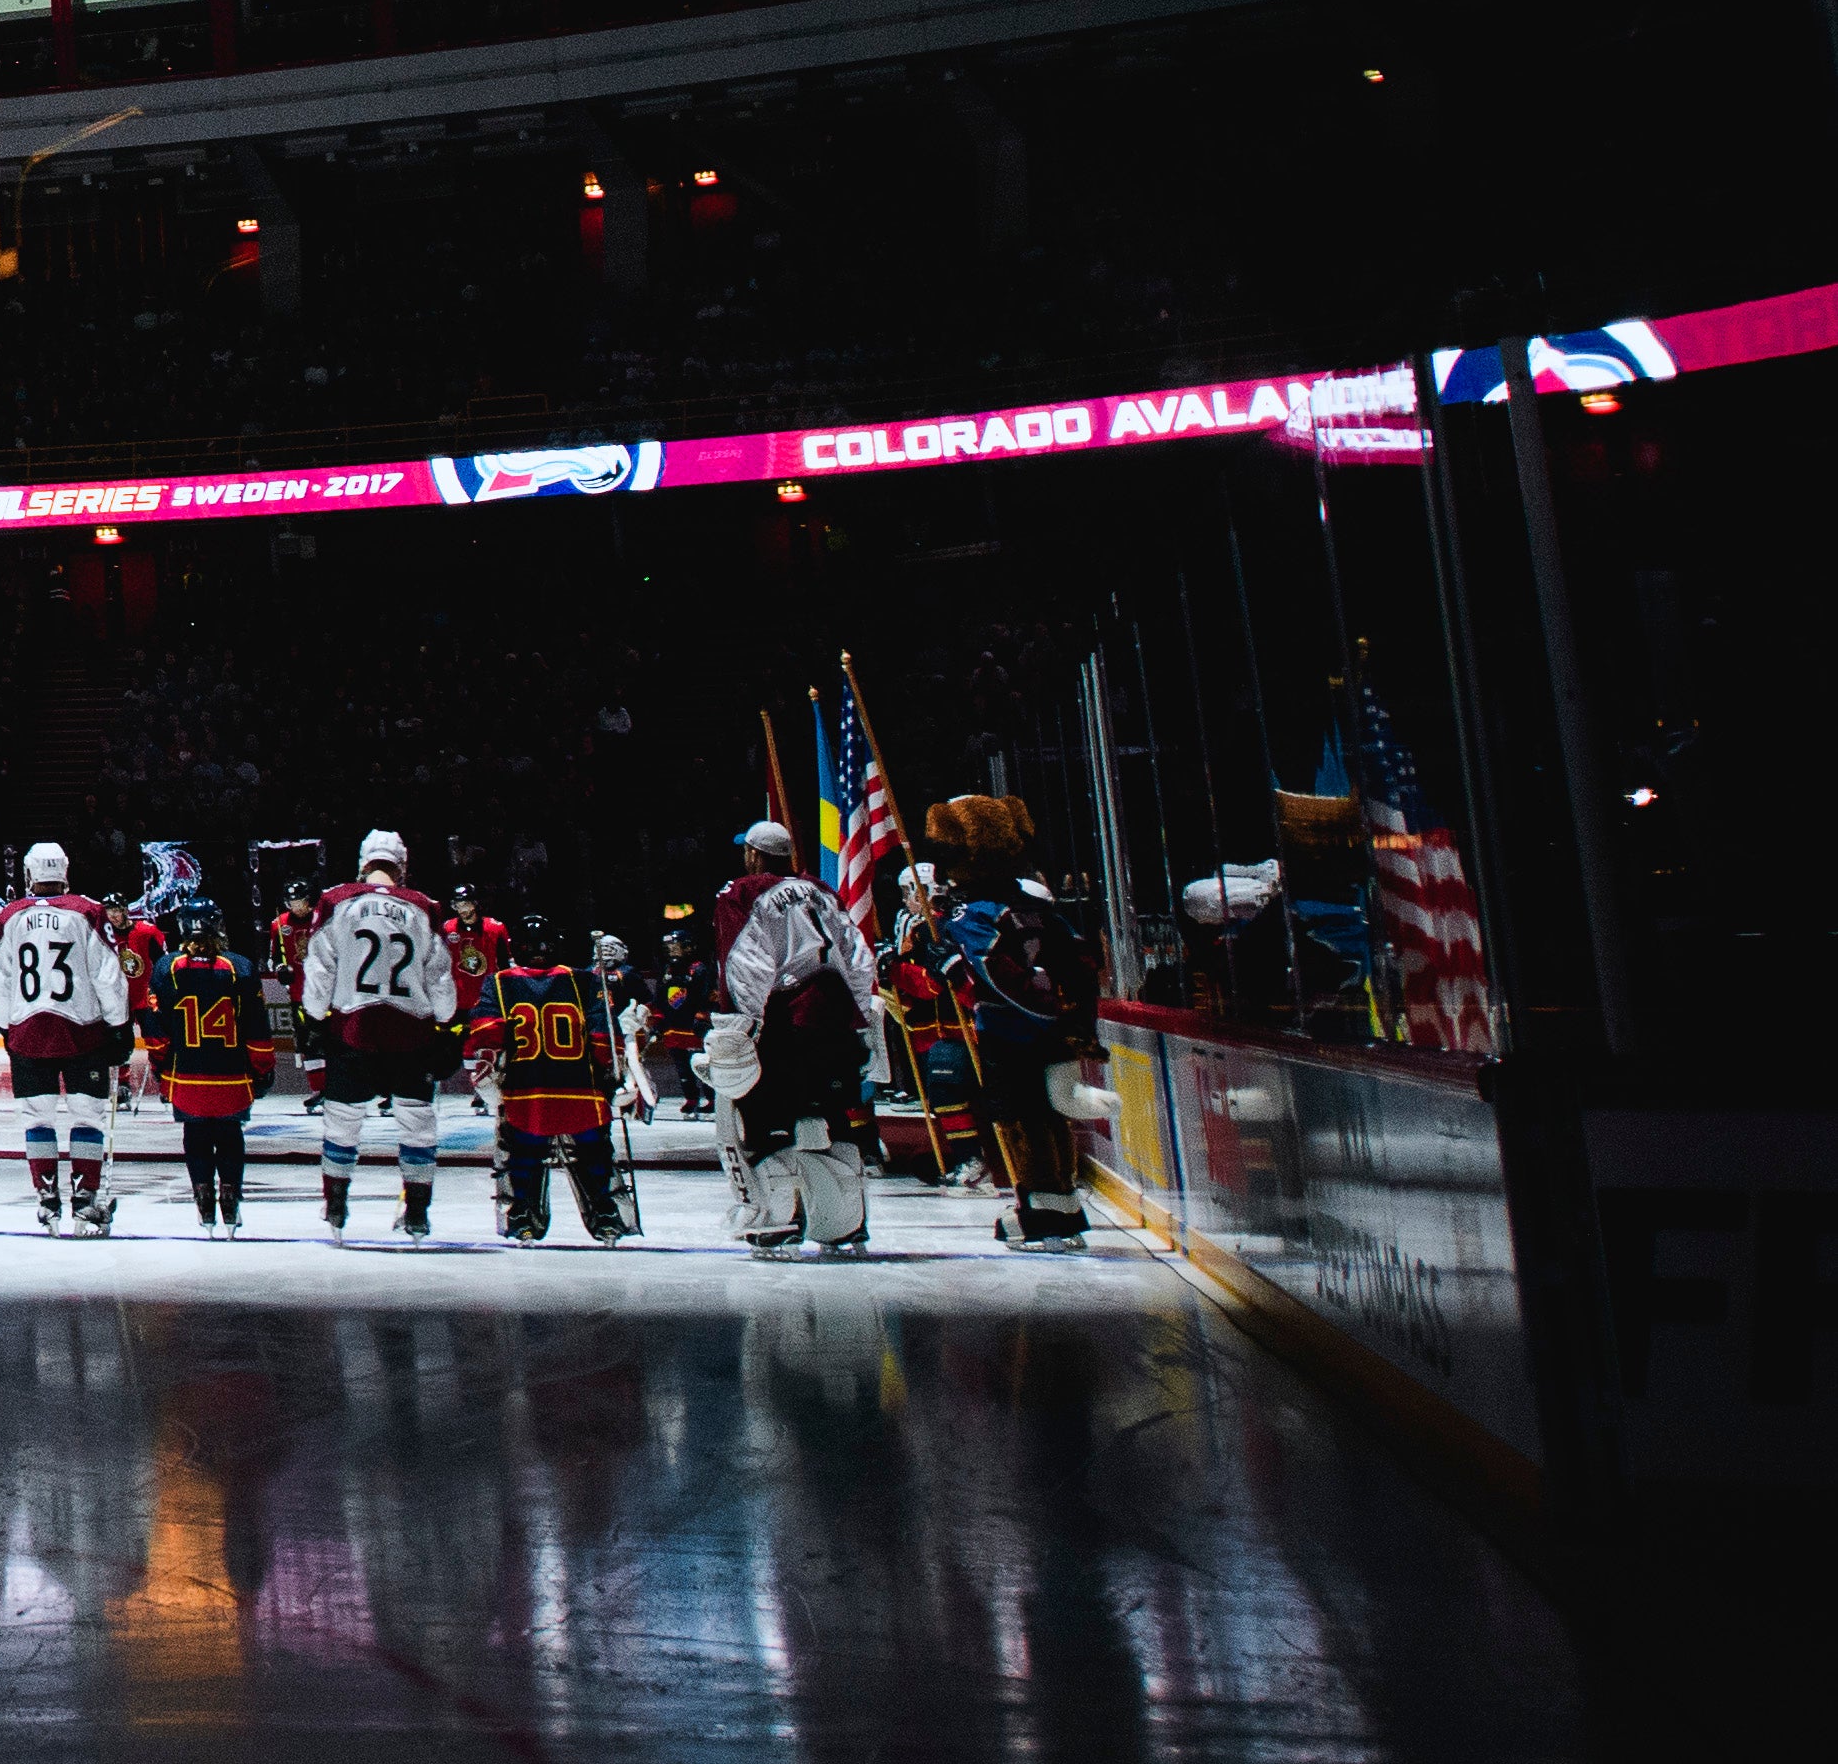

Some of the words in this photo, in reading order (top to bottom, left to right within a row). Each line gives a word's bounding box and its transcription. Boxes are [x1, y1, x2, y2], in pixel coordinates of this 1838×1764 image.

[802, 406, 1092, 470] COLORADO
[24, 484, 162, 517] SERIES
[170, 478, 310, 507] SWEDEN
[322, 472, 405, 498] 2017
[26, 912, 60, 932] NIETO
[18, 940, 75, 1003] 83
[354, 927, 414, 998] 22
[174, 995, 237, 1048] 14
[509, 1002, 585, 1061] 30
